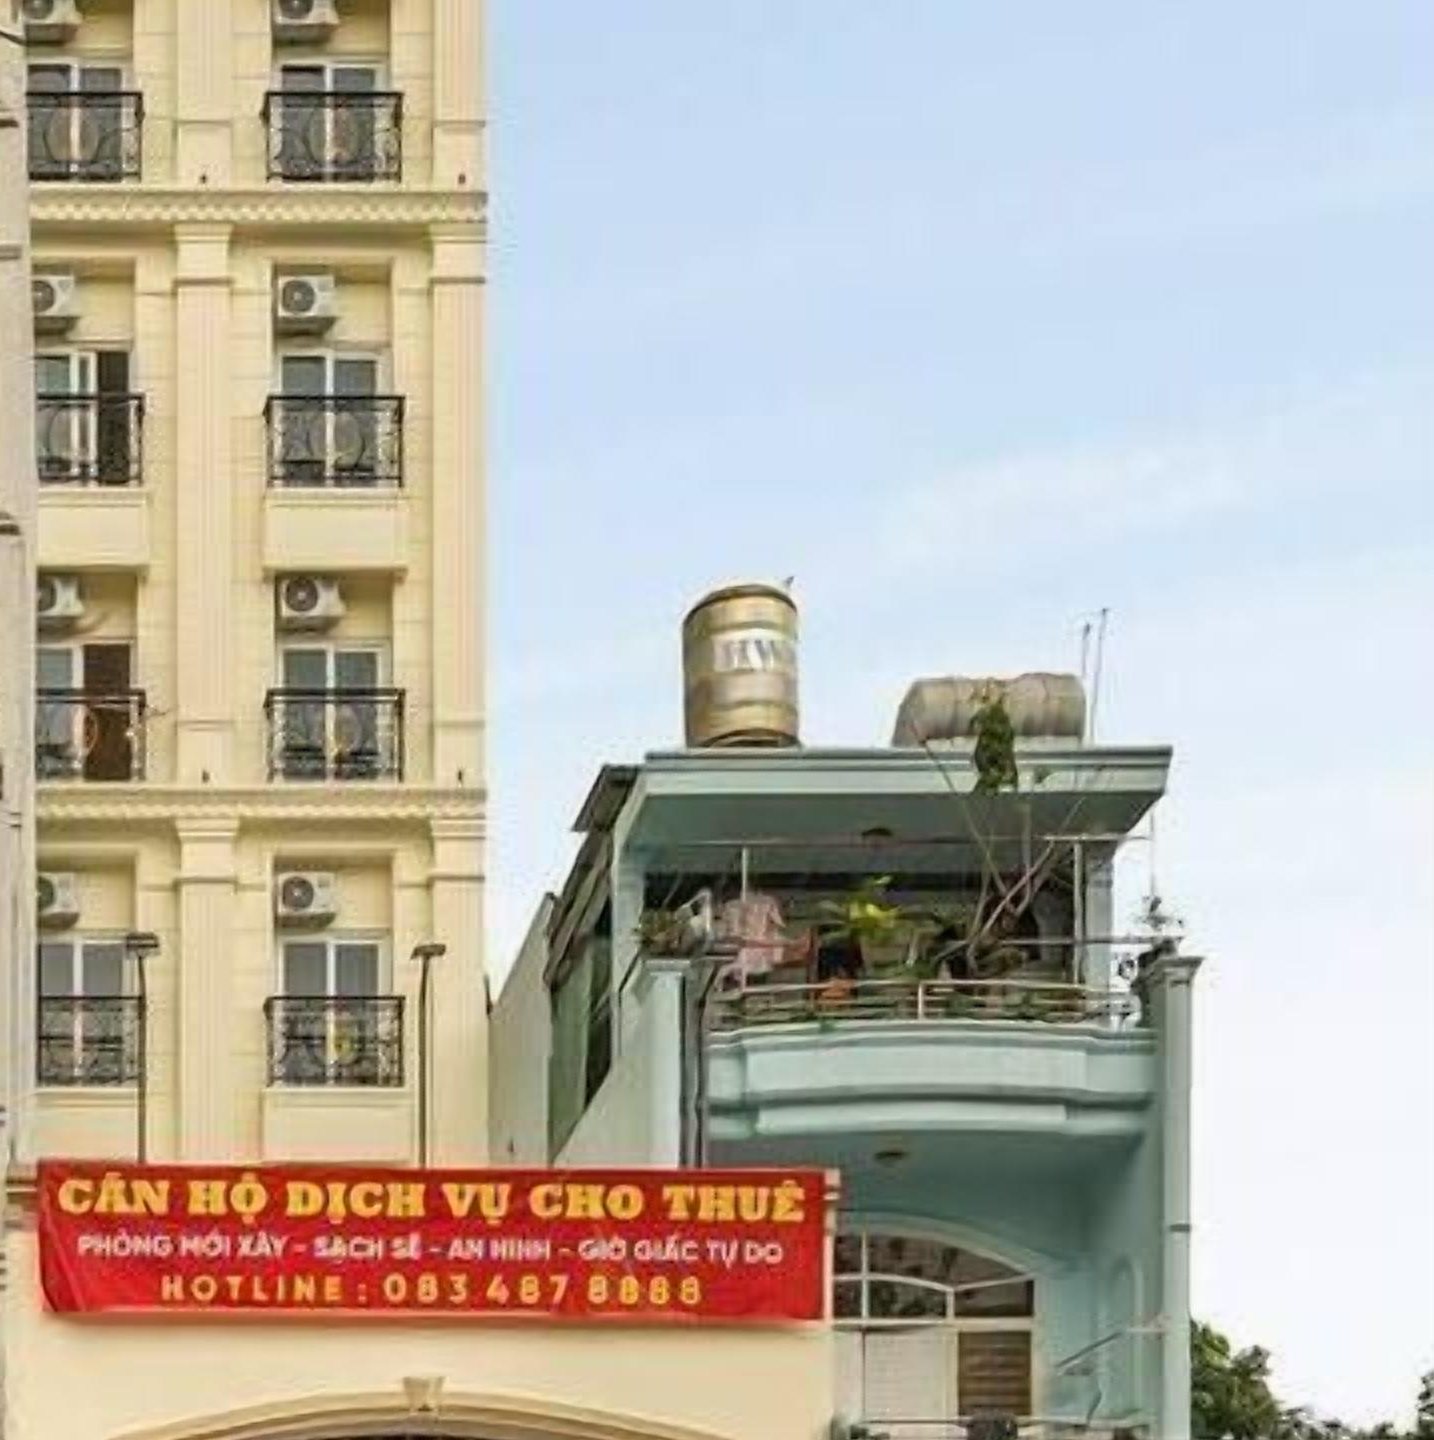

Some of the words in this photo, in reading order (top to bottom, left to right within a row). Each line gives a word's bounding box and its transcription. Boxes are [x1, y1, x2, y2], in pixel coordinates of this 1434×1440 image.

[187, 1173, 267, 1224] HỘ
[286, 1181, 425, 1224] DỊCH
[442, 1182, 512, 1226] VỤ
[528, 1184, 645, 1220] CHO
[663, 1180, 806, 1222] THUÊ
[447, 1238, 484, 1260] AN
[744, 1239, 784, 1264] DO
